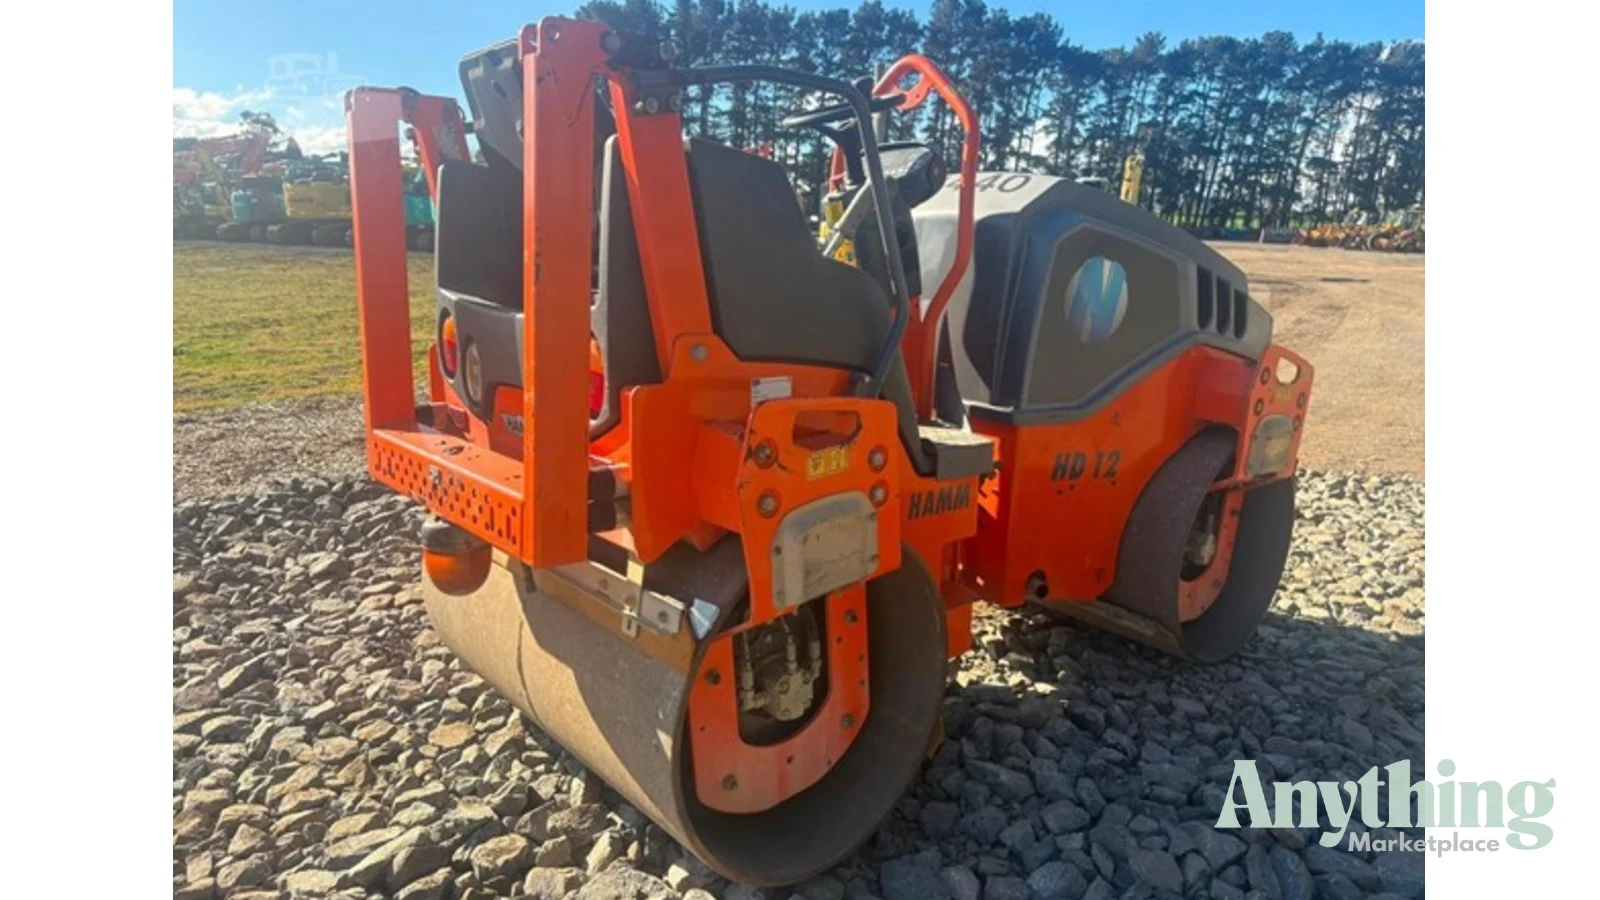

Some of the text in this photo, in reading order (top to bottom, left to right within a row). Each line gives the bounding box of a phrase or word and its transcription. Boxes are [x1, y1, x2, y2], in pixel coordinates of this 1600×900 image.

[1051, 450, 1121, 481] HD 12
[907, 484, 971, 521] HAMM
